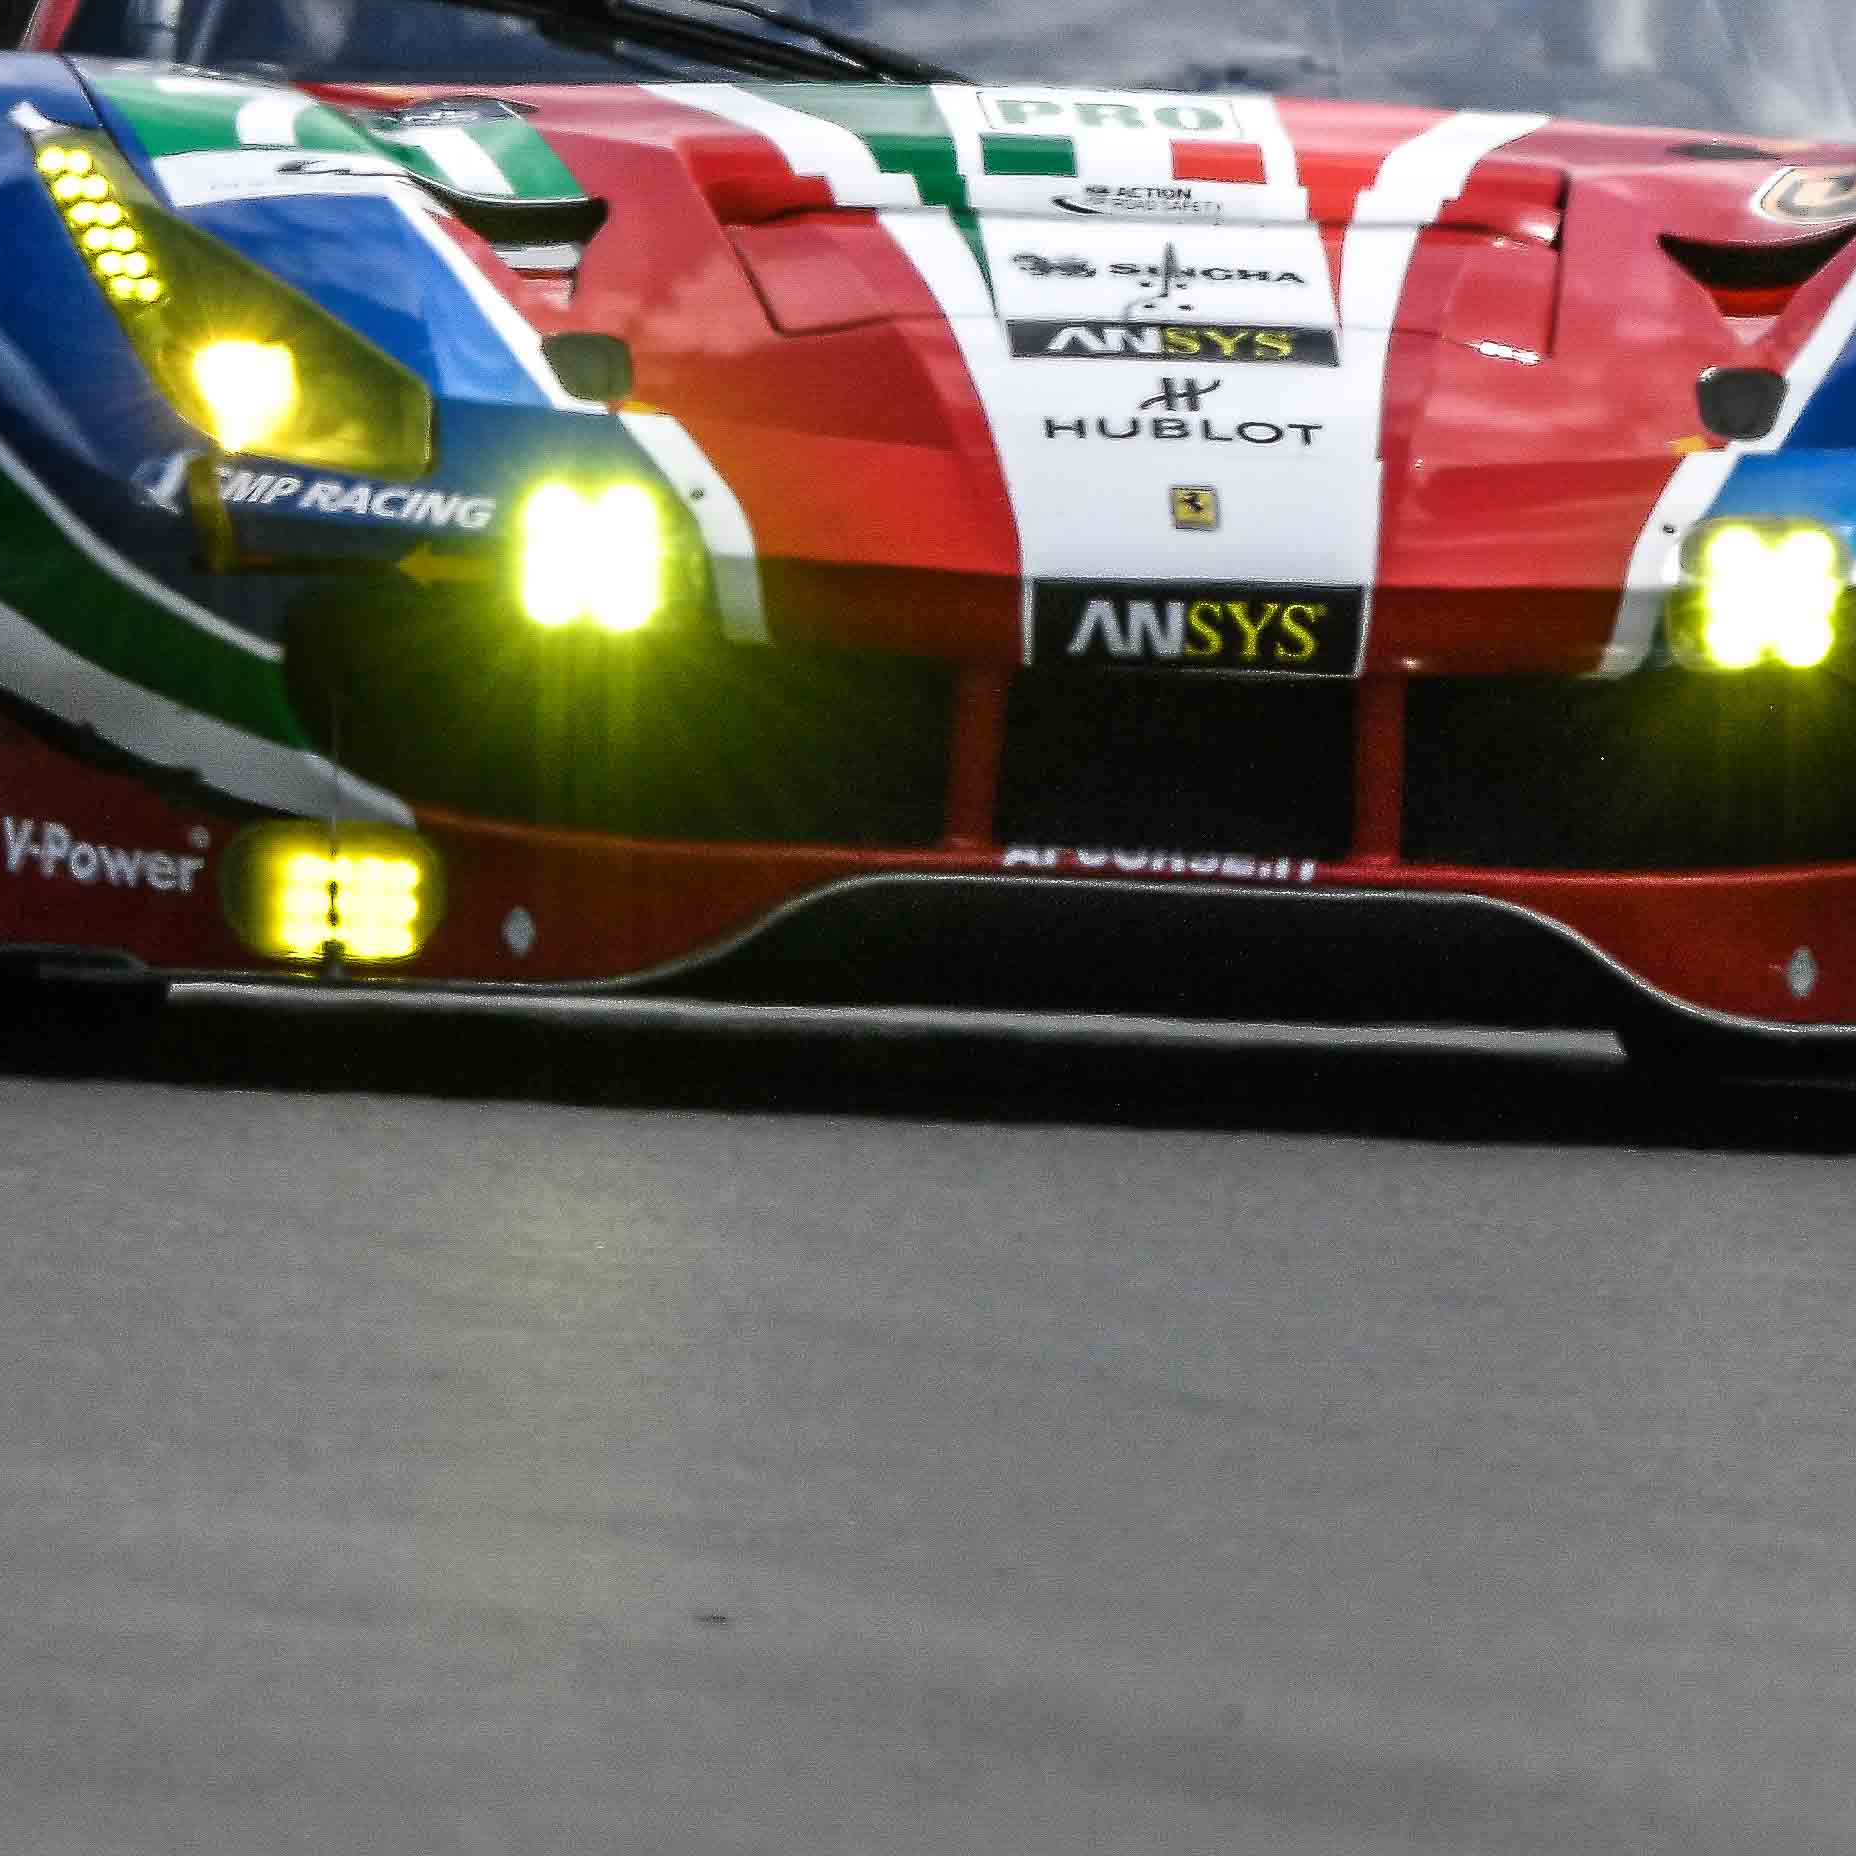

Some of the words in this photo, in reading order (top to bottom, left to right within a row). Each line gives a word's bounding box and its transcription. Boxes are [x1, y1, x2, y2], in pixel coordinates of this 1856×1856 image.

[996, 100, 1224, 131] PRO
[1046, 325, 1294, 359] ANSYS
[1043, 416, 1324, 446] HUBLOT
[298, 480, 496, 530] RACING
[1069, 600, 1318, 658] ANSYS
[0, 815, 205, 893] V-Power
